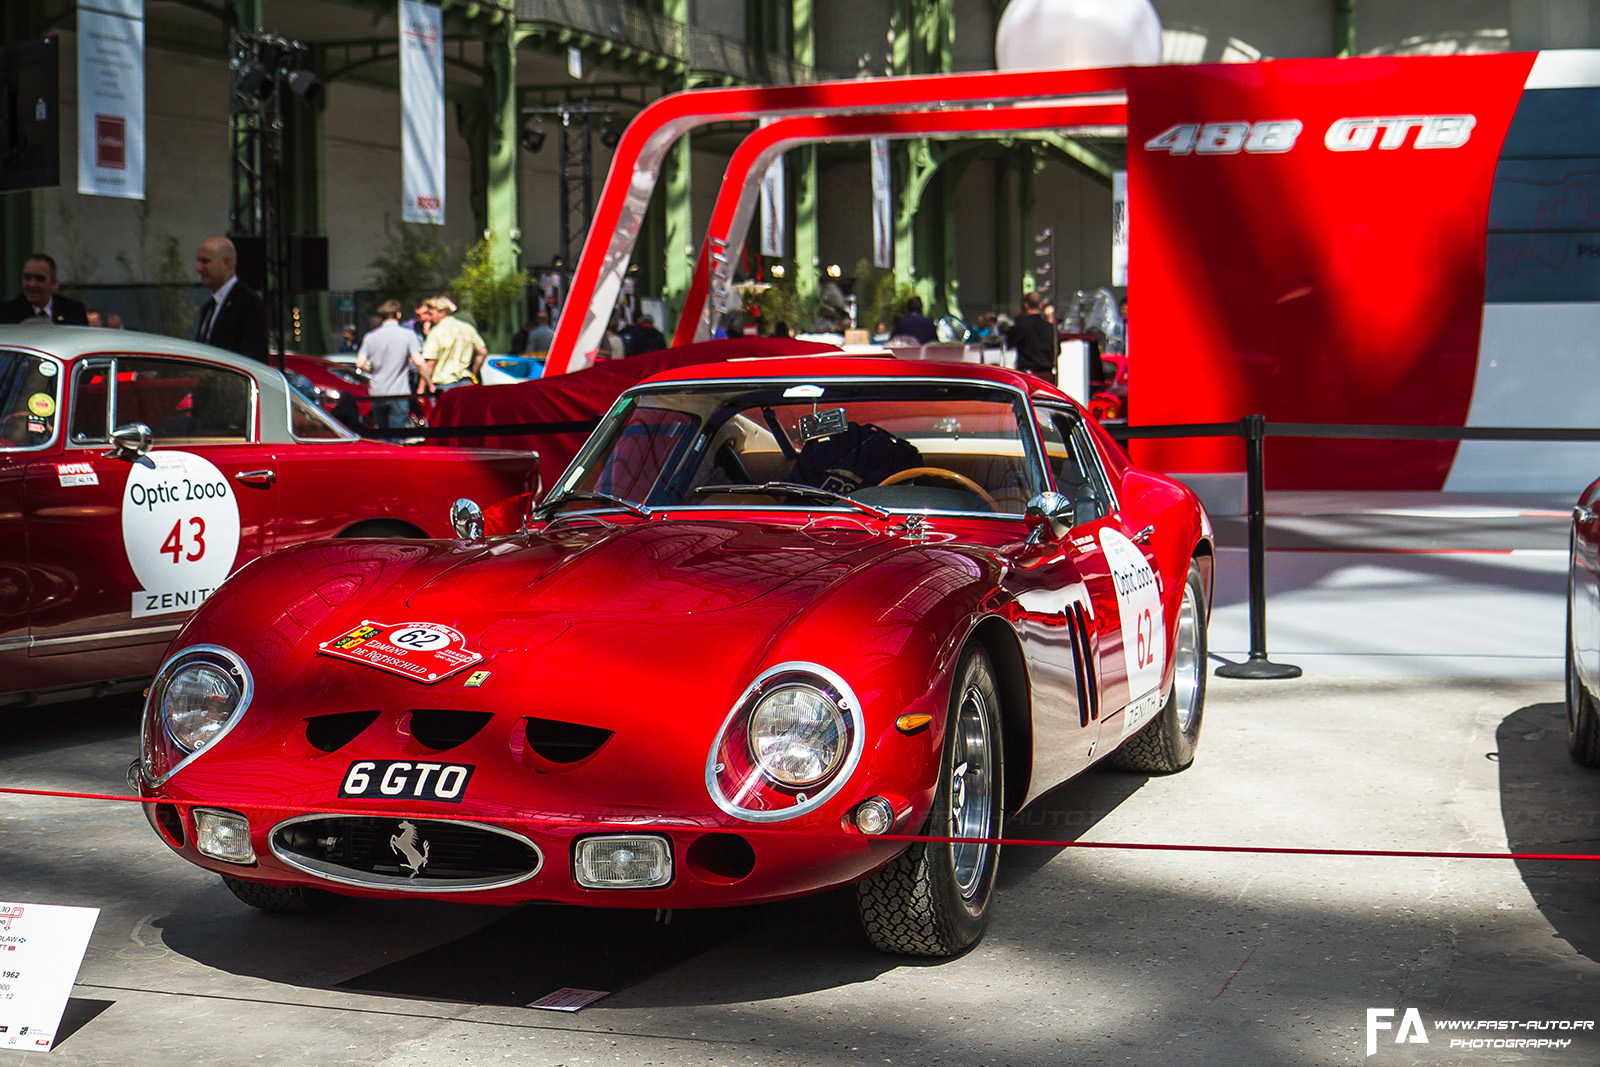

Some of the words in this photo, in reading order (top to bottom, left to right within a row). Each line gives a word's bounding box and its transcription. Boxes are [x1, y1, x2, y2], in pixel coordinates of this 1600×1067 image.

[1144, 119, 1303, 156] 488
[1324, 113, 1477, 152] GTB
[58, 463, 94, 474] MOTUL
[130, 480, 179, 511] Optic
[160, 517, 206, 564] 43
[145, 588, 215, 611] ZENIT
[1114, 568, 1137, 604] Optic
[364, 640, 409, 657] EDMOND
[397, 629, 440, 648] 62
[1136, 608, 1154, 670] 62
[350, 647, 369, 655] DE
[364, 650, 428, 674] ROTHSCHILD
[1127, 694, 1157, 727] ZENITH
[344, 761, 376, 795] 6
[380, 762, 468, 799] GTO
[2, 971, 20, 979] 1962
